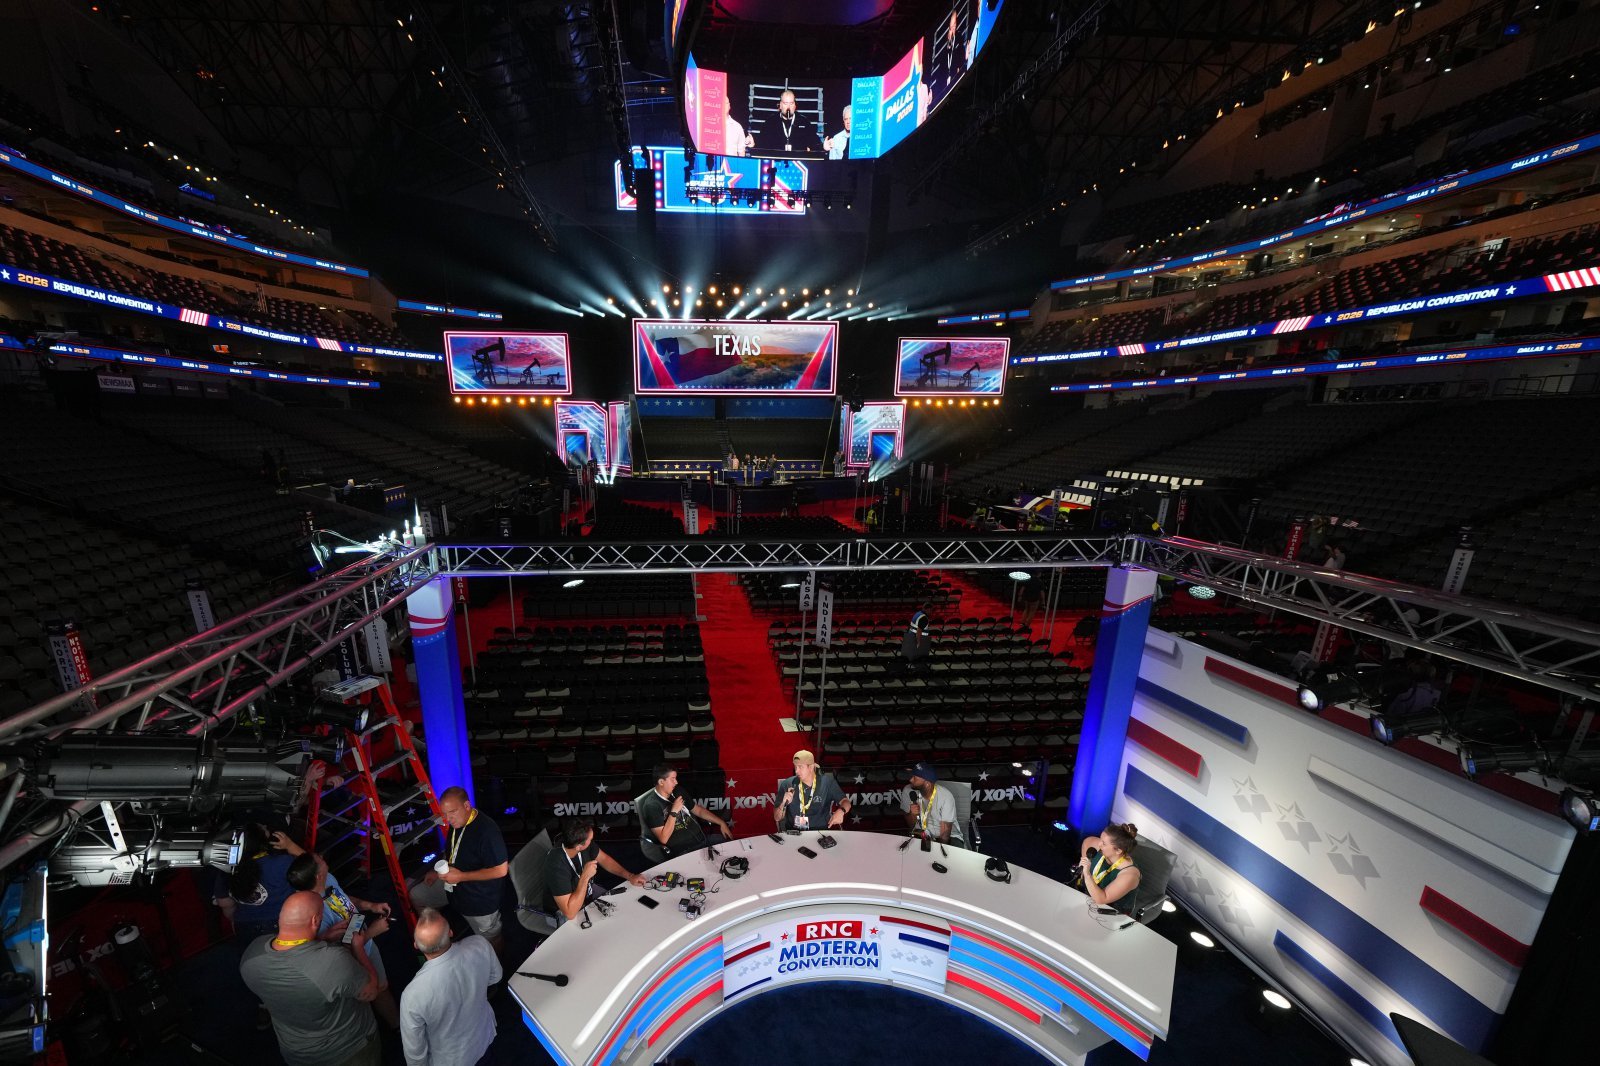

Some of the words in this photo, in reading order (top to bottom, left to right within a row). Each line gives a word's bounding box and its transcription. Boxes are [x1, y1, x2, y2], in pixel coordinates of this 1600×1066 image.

[885, 85, 914, 121] DALLAS
[1511, 156, 1540, 169] DALLAS
[1550, 144, 1579, 157] 2026
[1406, 190, 1429, 201] DALLAS
[1325, 217, 1343, 226] DALLAS
[18, 273, 48, 288] 2026
[53, 281, 105, 301] REPUBLICAN
[108, 294, 153, 312] CONVENTION
[1337, 310, 1363, 321] 2026
[1366, 300, 1425, 316] REPUBLICAN
[1426, 288, 1499, 306] CONVENTION
[243, 326, 269, 338] REPUBLICAN
[270, 332, 300, 343] CONVENTION
[1180, 336, 1211, 346] REPUBLICAN
[1212, 329, 1248, 340] CONVENTION
[713, 335, 761, 356] TEXAS
[1517, 345, 1545, 353] DALLAS
[1555, 342, 1582, 350] 2026
[100, 378, 133, 388] NEWSMAX
[820, 595, 828, 644] INDIANA
[806, 923, 853, 939] RNC
[778, 941, 879, 963] MIDTERM
[778, 957, 879, 974] CONVENTION
